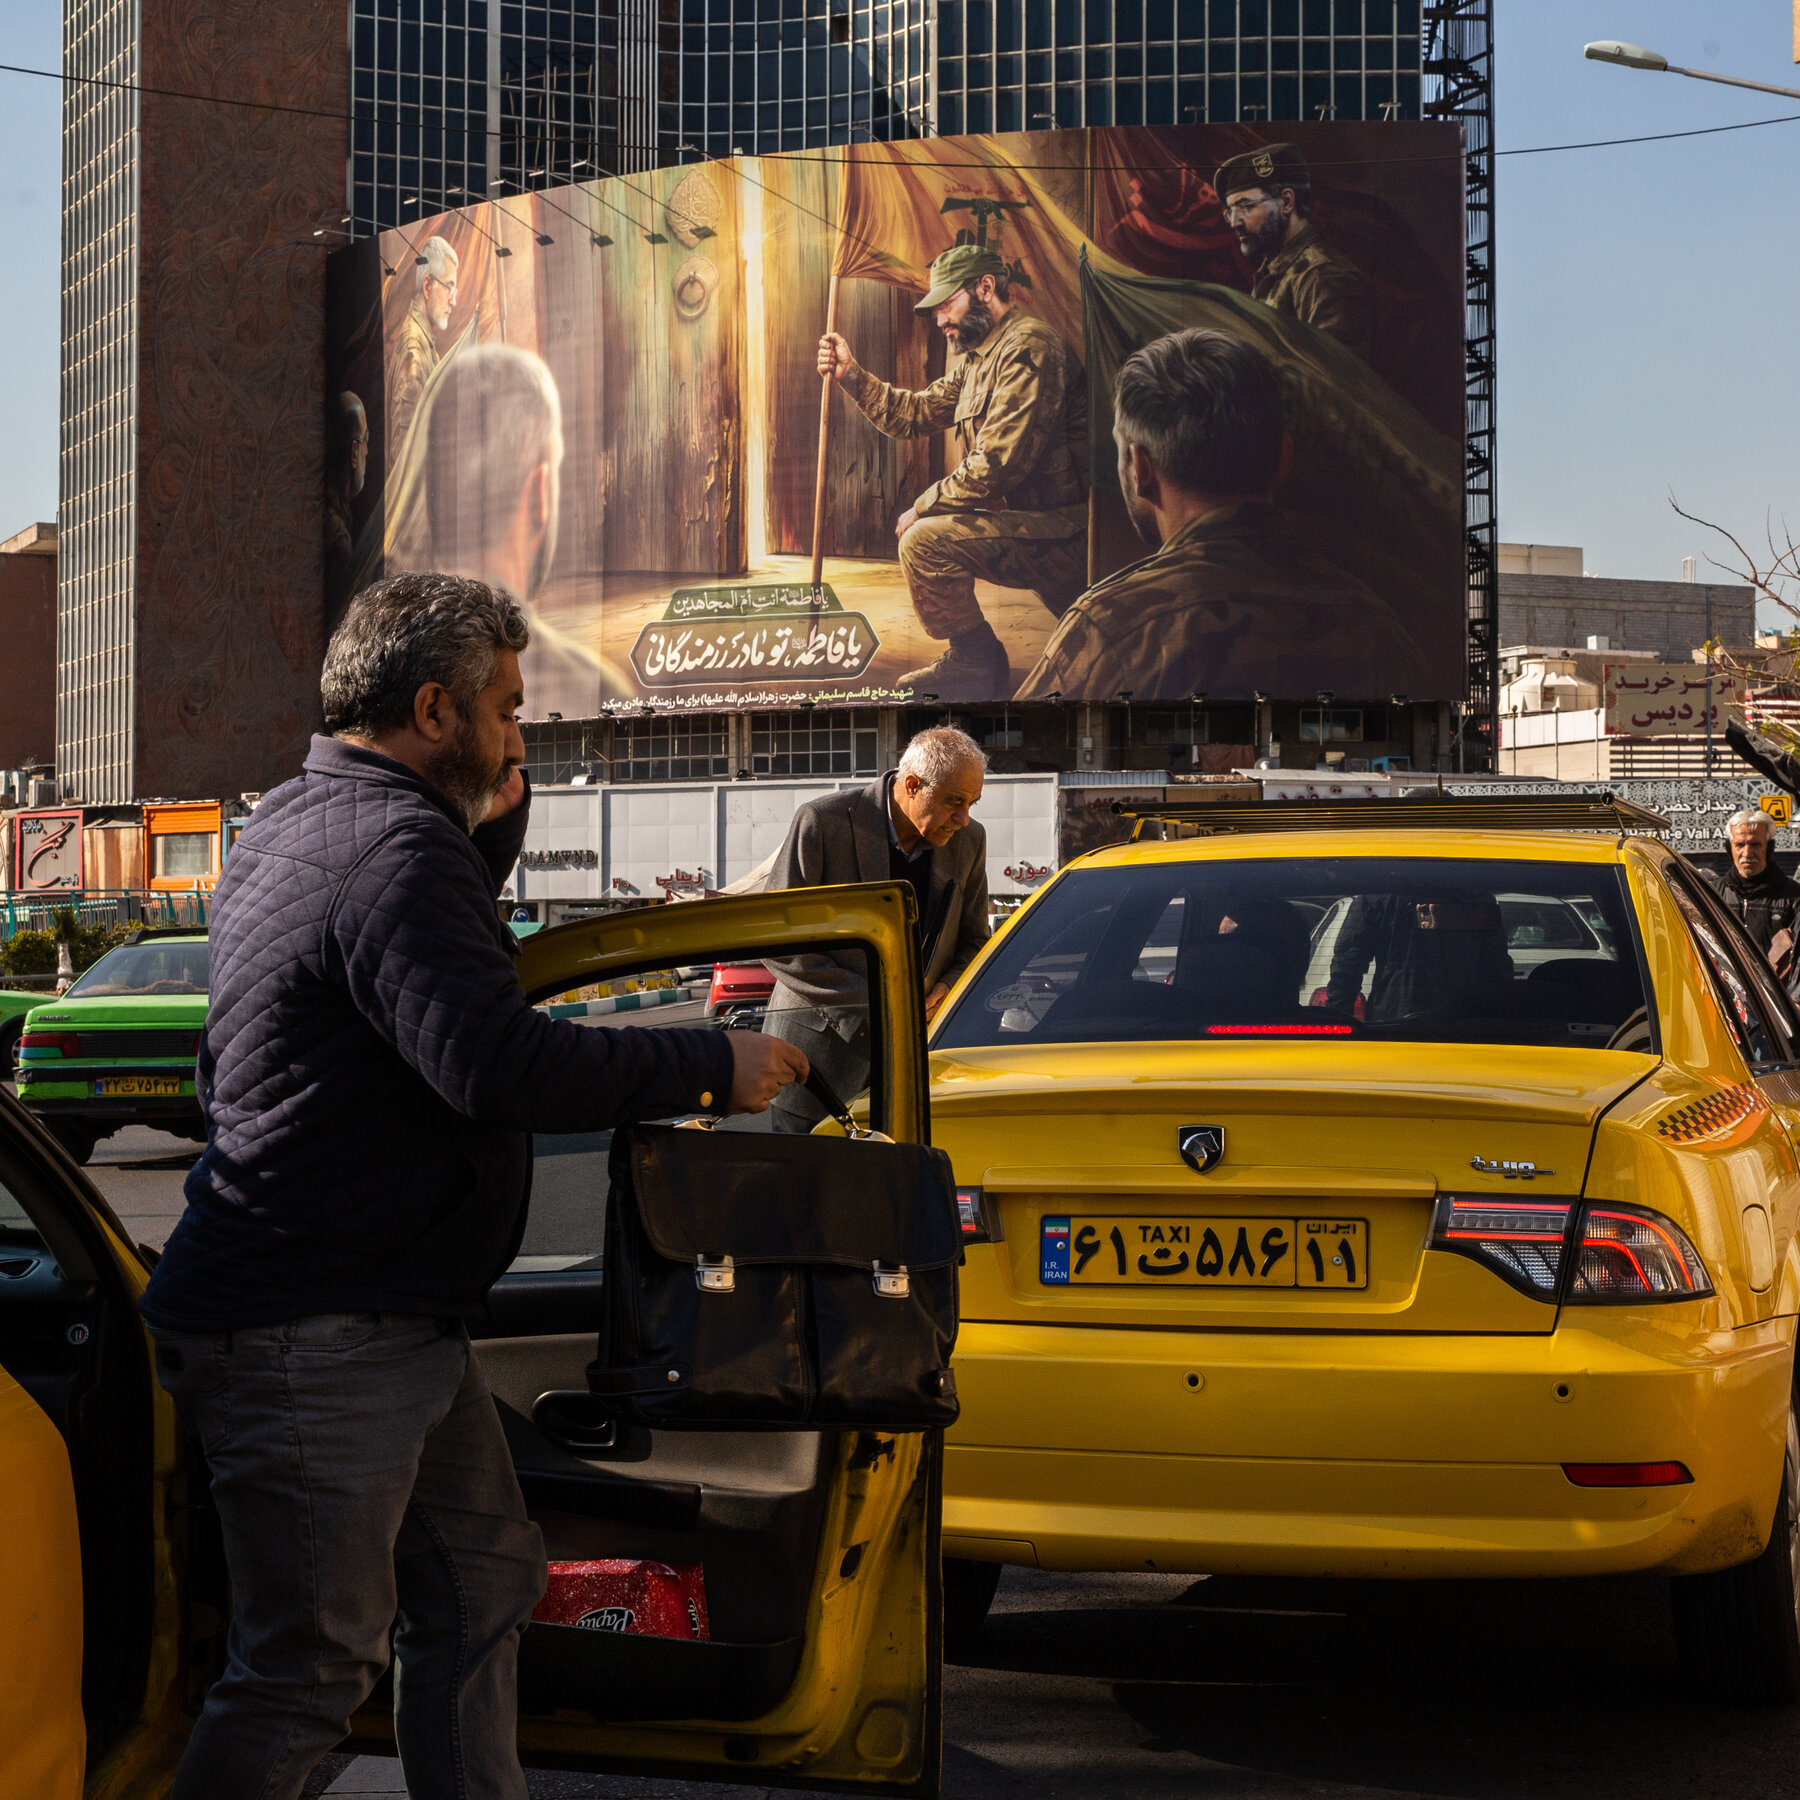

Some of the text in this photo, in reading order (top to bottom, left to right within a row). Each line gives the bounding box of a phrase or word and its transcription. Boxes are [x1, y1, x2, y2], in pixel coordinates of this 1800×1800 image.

[766, 627, 793, 666] تو
[1615, 671, 1675, 694] خرید
[675, 694, 685, 706] ما
[779, 691, 807, 704] حضرت
[846, 686, 871, 702] قاسم
[871, 687, 889, 700] حاج
[889, 686, 914, 700] شهید
[622, 696, 644, 711] مادری
[684, 694, 700, 708] برای
[1632, 703, 1719, 728] پردیس
[1695, 799, 1736, 815] میدان
[1686, 827, 1710, 839] Vali
[1003, 859, 1049, 881] موزه
[1138, 1225, 1191, 1243] TAXI
[1044, 1270, 1068, 1279] IRAN
